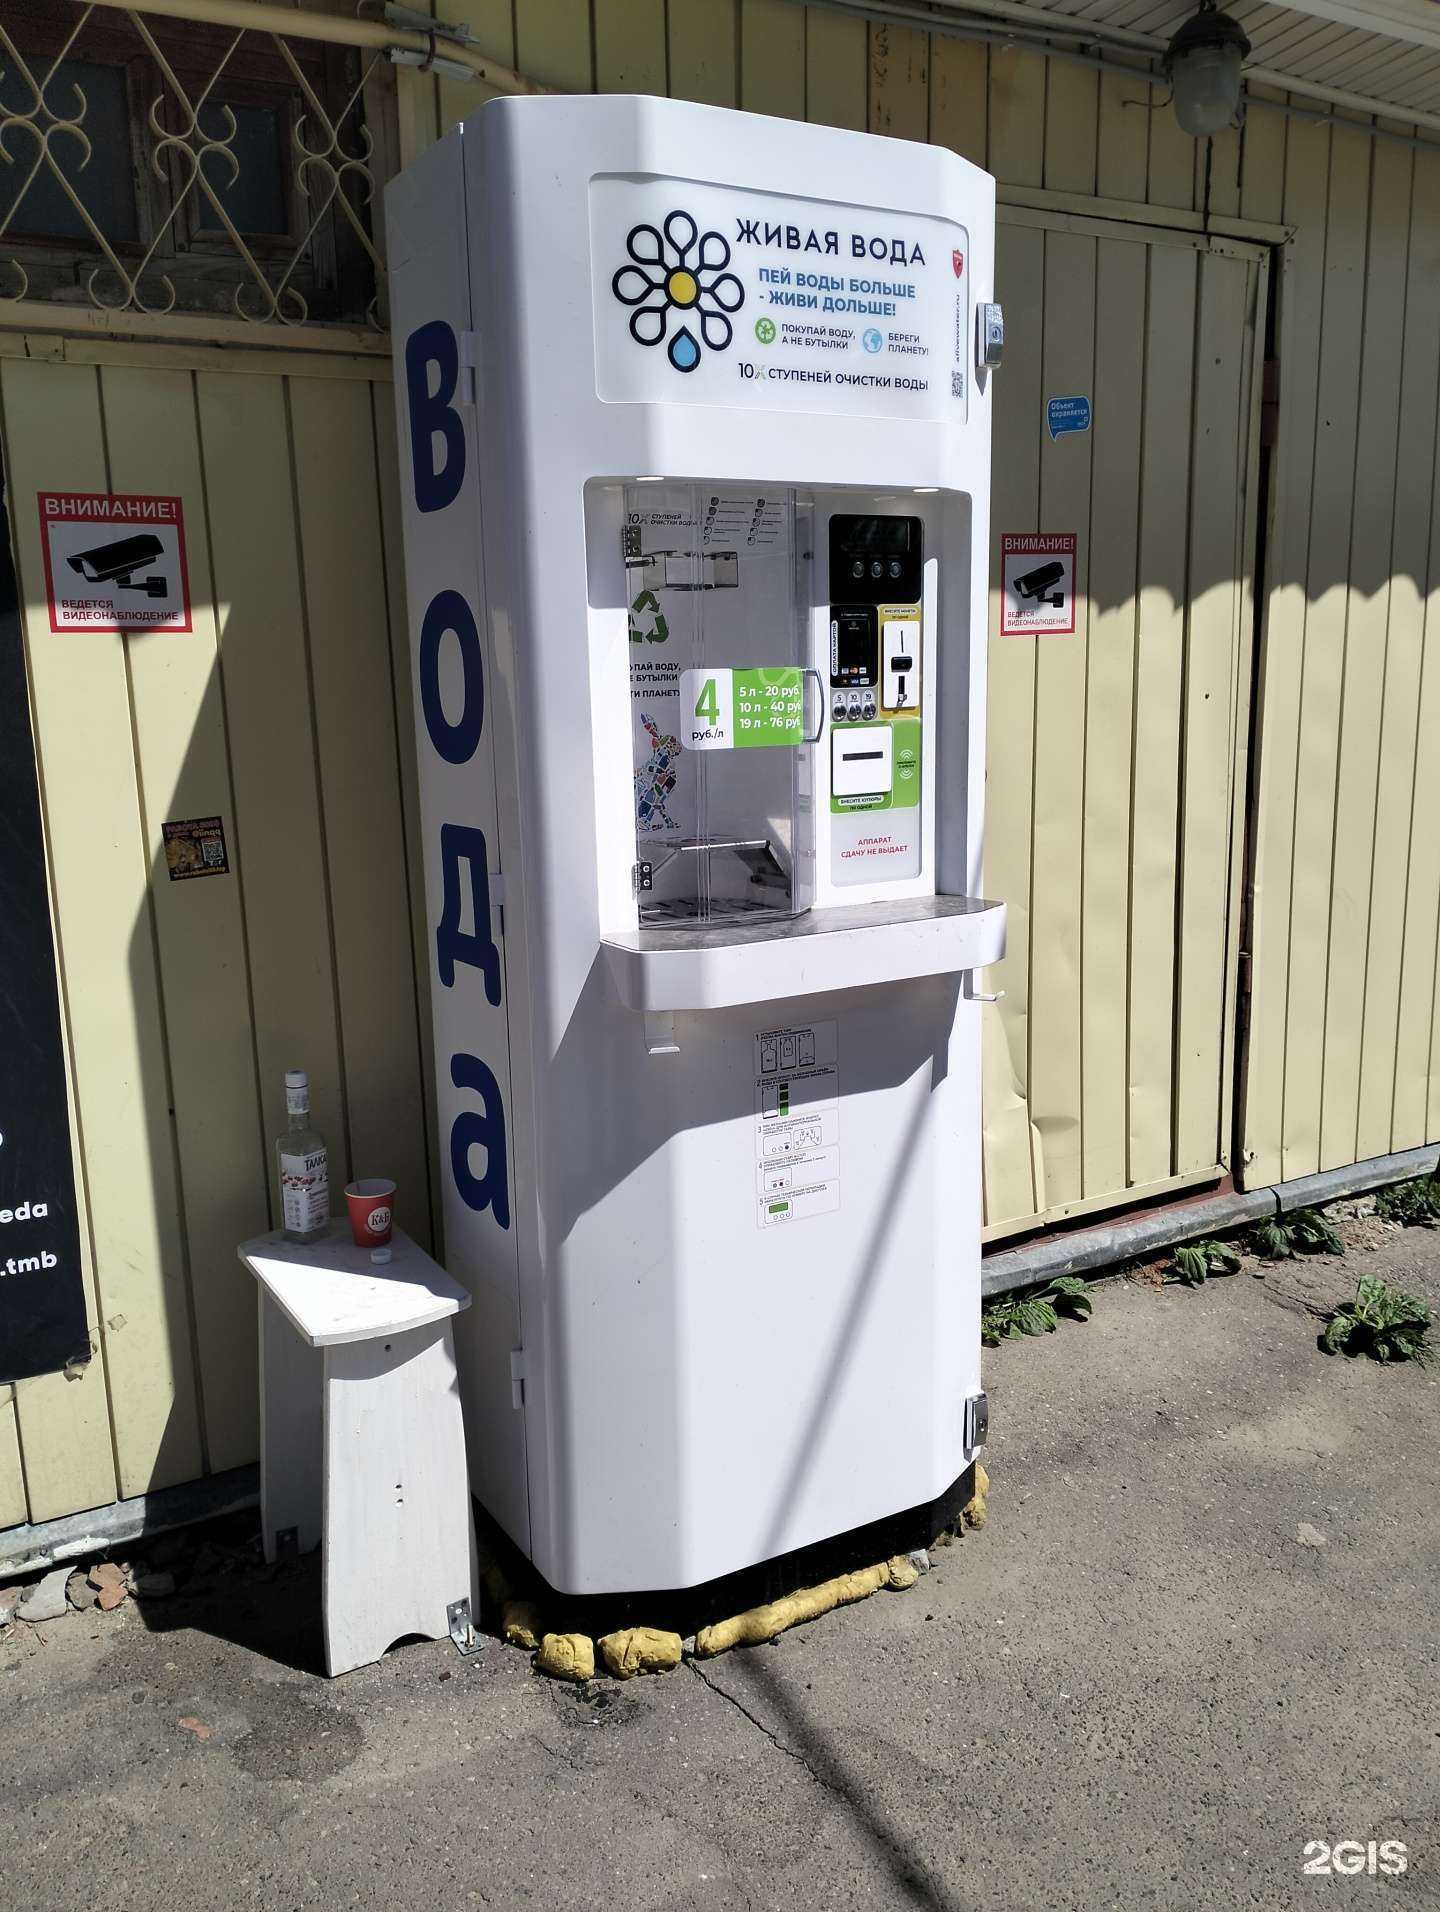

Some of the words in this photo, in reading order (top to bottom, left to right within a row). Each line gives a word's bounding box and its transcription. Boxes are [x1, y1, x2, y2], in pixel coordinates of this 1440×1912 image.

[736, 217, 839, 255] ЖИВАЯ
[851, 233, 926, 267] ВОДА
[759, 267, 791, 285] ПЕЙ
[796, 272, 844, 291] ВОДЫ
[849, 279, 916, 298] БОЛЬШЕ
[769, 290, 818, 309] ЖИВИ
[822, 296, 896, 316] ДОЛЬШЕ!
[781, 323, 827, 337] ПОКУПАЙ
[828, 329, 856, 339] ВОДУ,
[781, 337, 789, 345] А
[791, 337, 803, 346] НЕ
[805, 338, 849, 350] БУТЫЛКИ
[888, 332, 920, 344] БЕРЕГИ
[768, 366, 832, 385] СТУПЕНЕЙ
[835, 373, 891, 389] ОЧИСТКИ
[894, 377, 929, 392] ВОДЫ
[45, 498, 177, 519] ВНИМАНИЕ!
[1005, 537, 1075, 551] ВНИМАНИЕ!
[62, 599, 114, 610] ВЕДЕТСЯ
[63, 611, 179, 622] ВИДЕОНАБЛЮДЕНИЕ
[1007, 610, 1035, 619] ВЕДЕТСЯ
[1007, 617, 1069, 627] ВИДЕОНАБЛЮДЕНИЕ
[655, 663, 681, 672] ВОДУ,
[636, 674, 678, 682] БУТЫЛКИ
[739, 687, 747, 697] 5
[749, 688, 756, 696] л
[765, 685, 779, 696] 20
[694, 678, 720, 726] 4
[739, 702, 752, 712] 10
[754, 703, 761, 712] л
[770, 701, 785, 711] 40
[739, 718, 752, 728] 19
[753, 719, 761, 728] л
[769, 717, 783, 727] 76
[692, 728, 724, 741] руб./л
[858, 836, 892, 846] АППАРАТ
[841, 849, 866, 858] СДАЧУ
[878, 845, 908, 854] ВЫДАЕТ
[0, 1201, 48, 1223] eda
